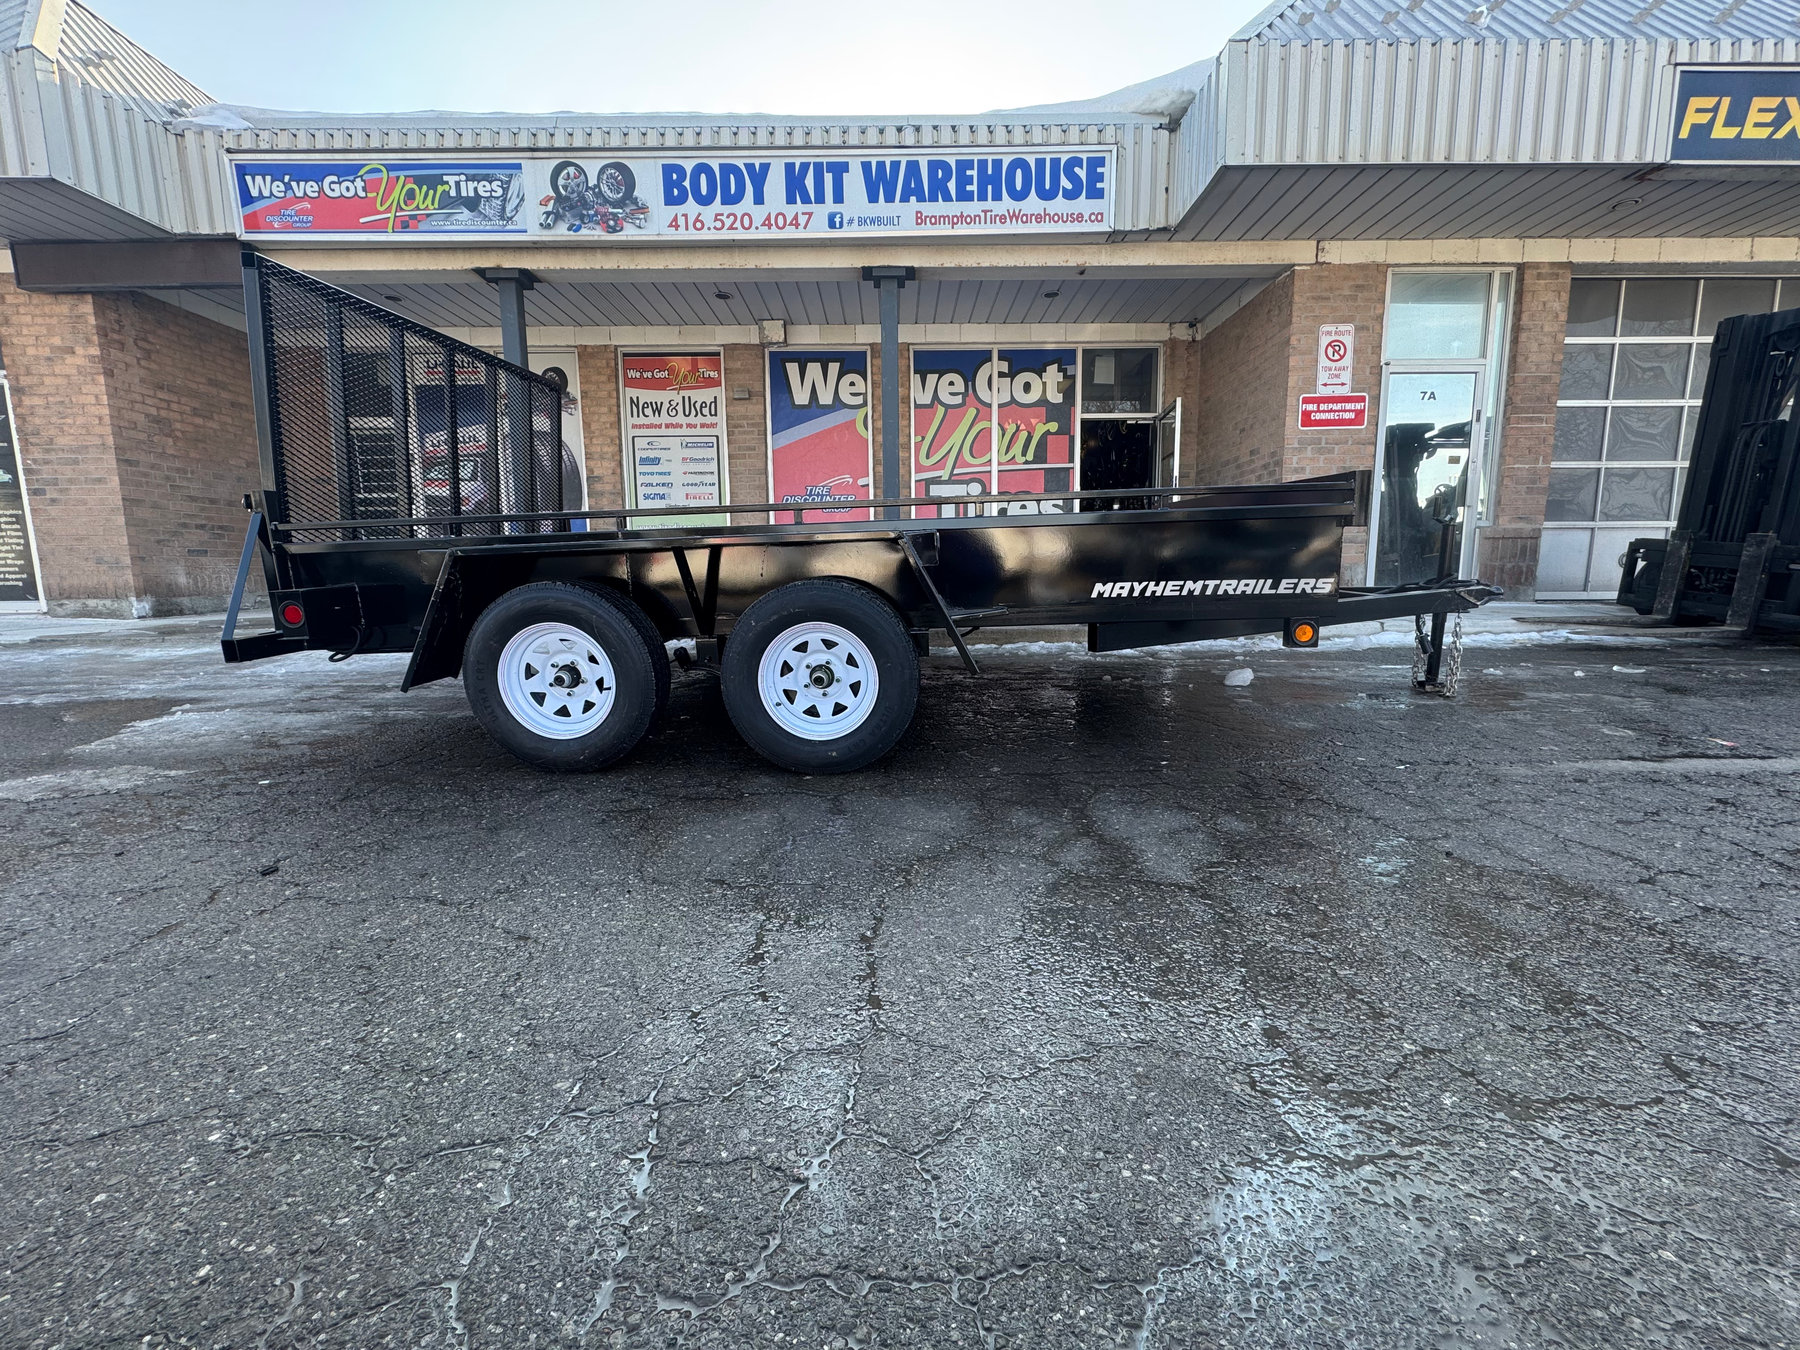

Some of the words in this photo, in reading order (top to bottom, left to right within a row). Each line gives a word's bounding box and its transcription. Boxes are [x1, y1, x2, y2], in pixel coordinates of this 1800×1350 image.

[661, 162, 771, 207] BODY
[784, 161, 850, 205] KIT
[860, 156, 1106, 204] WAREHOUSE
[245, 174, 320, 198] We've
[323, 175, 368, 198] Got
[358, 163, 450, 233] Your
[443, 173, 503, 197] Tires
[431, 217, 518, 227] www.tirediscounter.ca
[667, 211, 814, 231] 416.520.4047
[857, 215, 901, 227] BKWBUILT
[915, 207, 1104, 229] BramptonTireWarehouse.ca
[627, 368, 652, 379] We've
[653, 368, 669, 379] Got
[666, 362, 700, 395] Your
[698, 368, 719, 378] Tires
[975, 360, 1064, 405] Got
[1420, 391, 1437, 401] 7A
[629, 395, 663, 418] New
[666, 399, 680, 418] &
[682, 395, 718, 418] Used
[1302, 403, 1318, 411] FIRE
[1319, 402, 1365, 411] DEPARTMENT
[1310, 412, 1356, 420] CONNECTION
[631, 422, 662, 430] Installed
[664, 422, 684, 430] While
[915, 405, 1059, 480] Your
[805, 486, 831, 495] TIRE
[1091, 577, 1335, 598] MAYHEMTRAILERS
